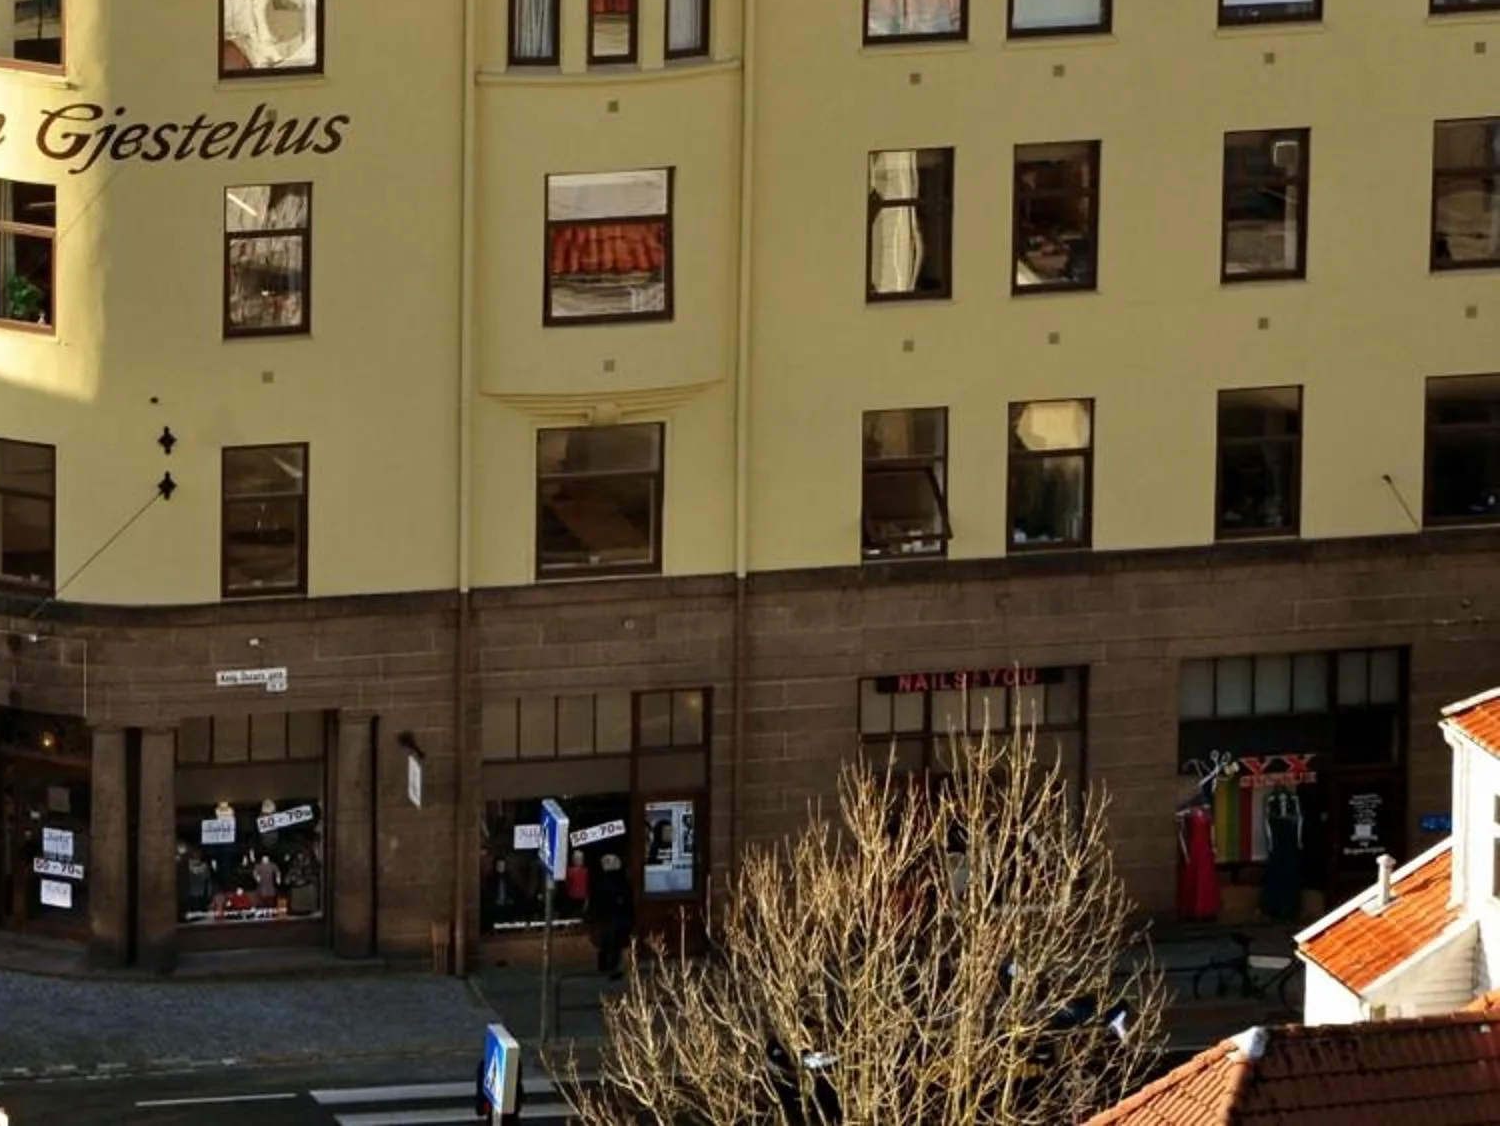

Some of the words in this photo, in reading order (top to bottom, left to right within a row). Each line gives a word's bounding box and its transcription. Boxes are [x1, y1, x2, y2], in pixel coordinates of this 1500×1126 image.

[35, 102, 351, 175] Gjestehus
[899, 672, 966, 691] NAILS
[988, 668, 1036, 685] YOU
